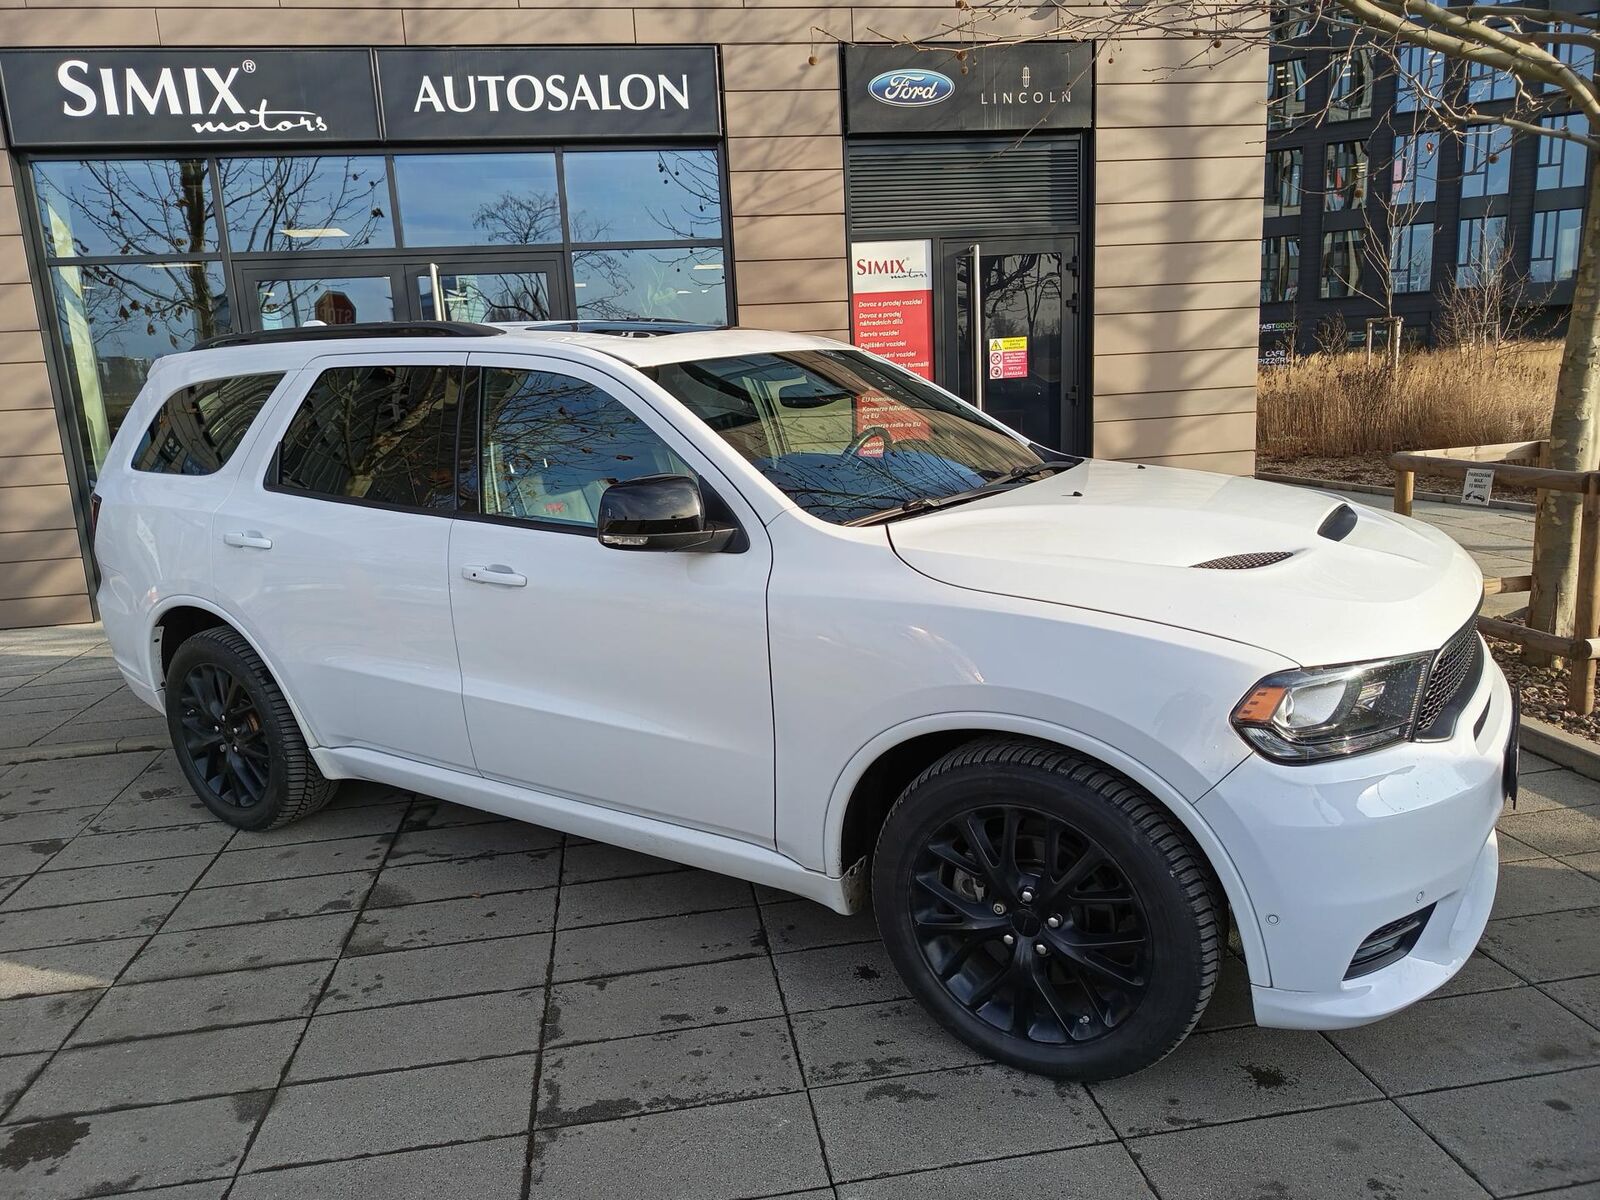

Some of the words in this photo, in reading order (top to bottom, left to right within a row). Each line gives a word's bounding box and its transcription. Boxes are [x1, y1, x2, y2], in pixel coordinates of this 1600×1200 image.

[413, 73, 690, 113] AUTOSALON
[884, 74, 939, 100] Ford
[981, 91, 1072, 105] LINCOLN
[192, 99, 328, 133] motors
